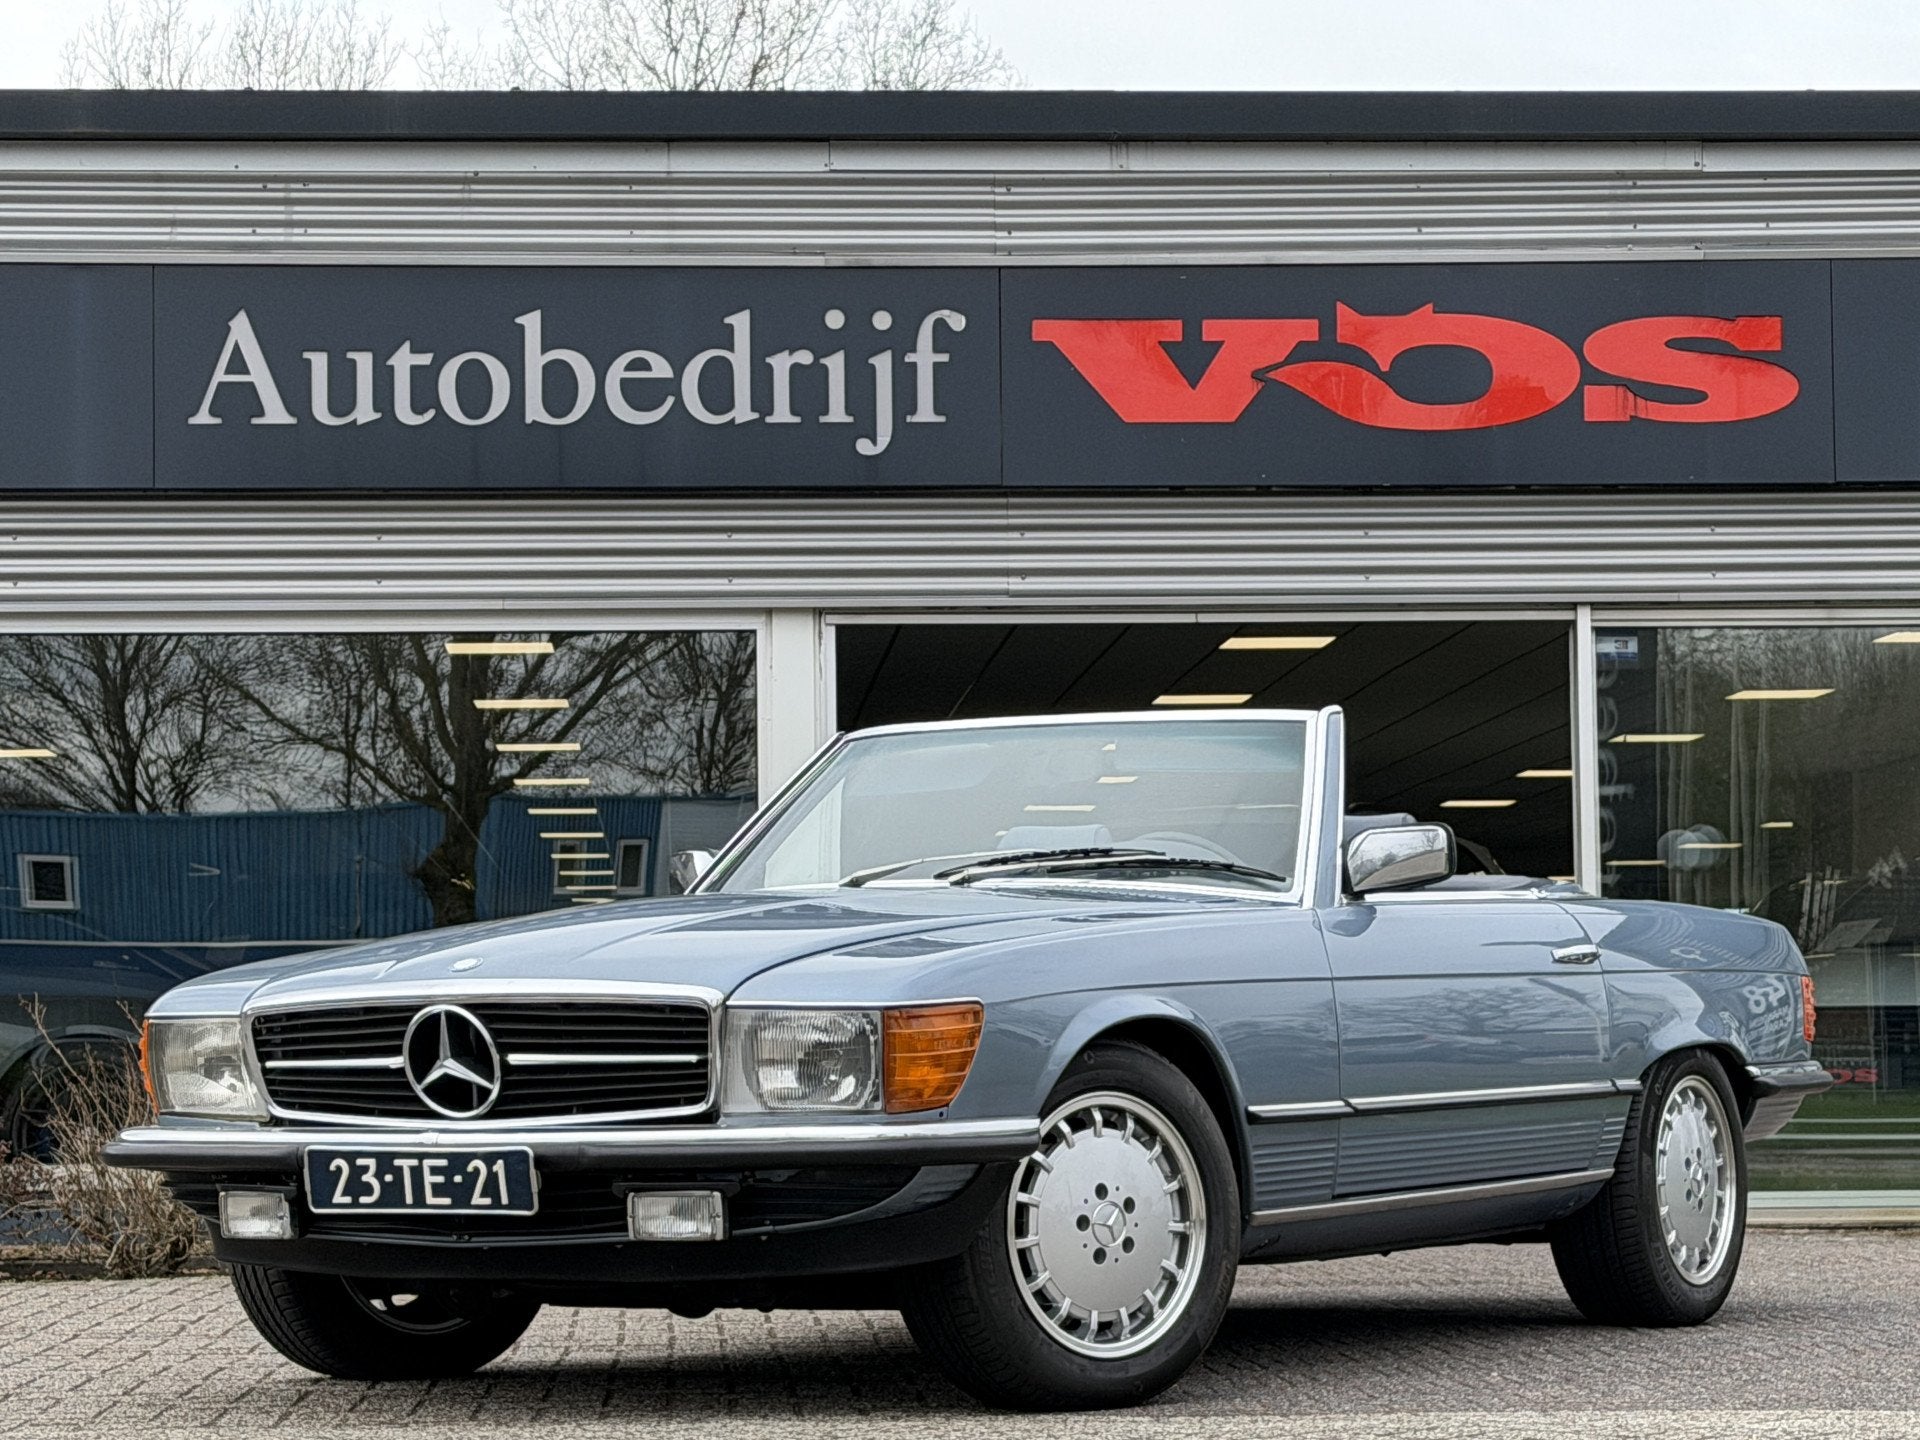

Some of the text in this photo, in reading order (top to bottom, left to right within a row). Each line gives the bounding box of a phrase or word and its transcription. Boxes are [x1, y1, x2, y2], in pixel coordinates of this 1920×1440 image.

[188, 301, 1800, 457] Autobedrijf VOS
[1825, 1066, 1879, 1085] OS
